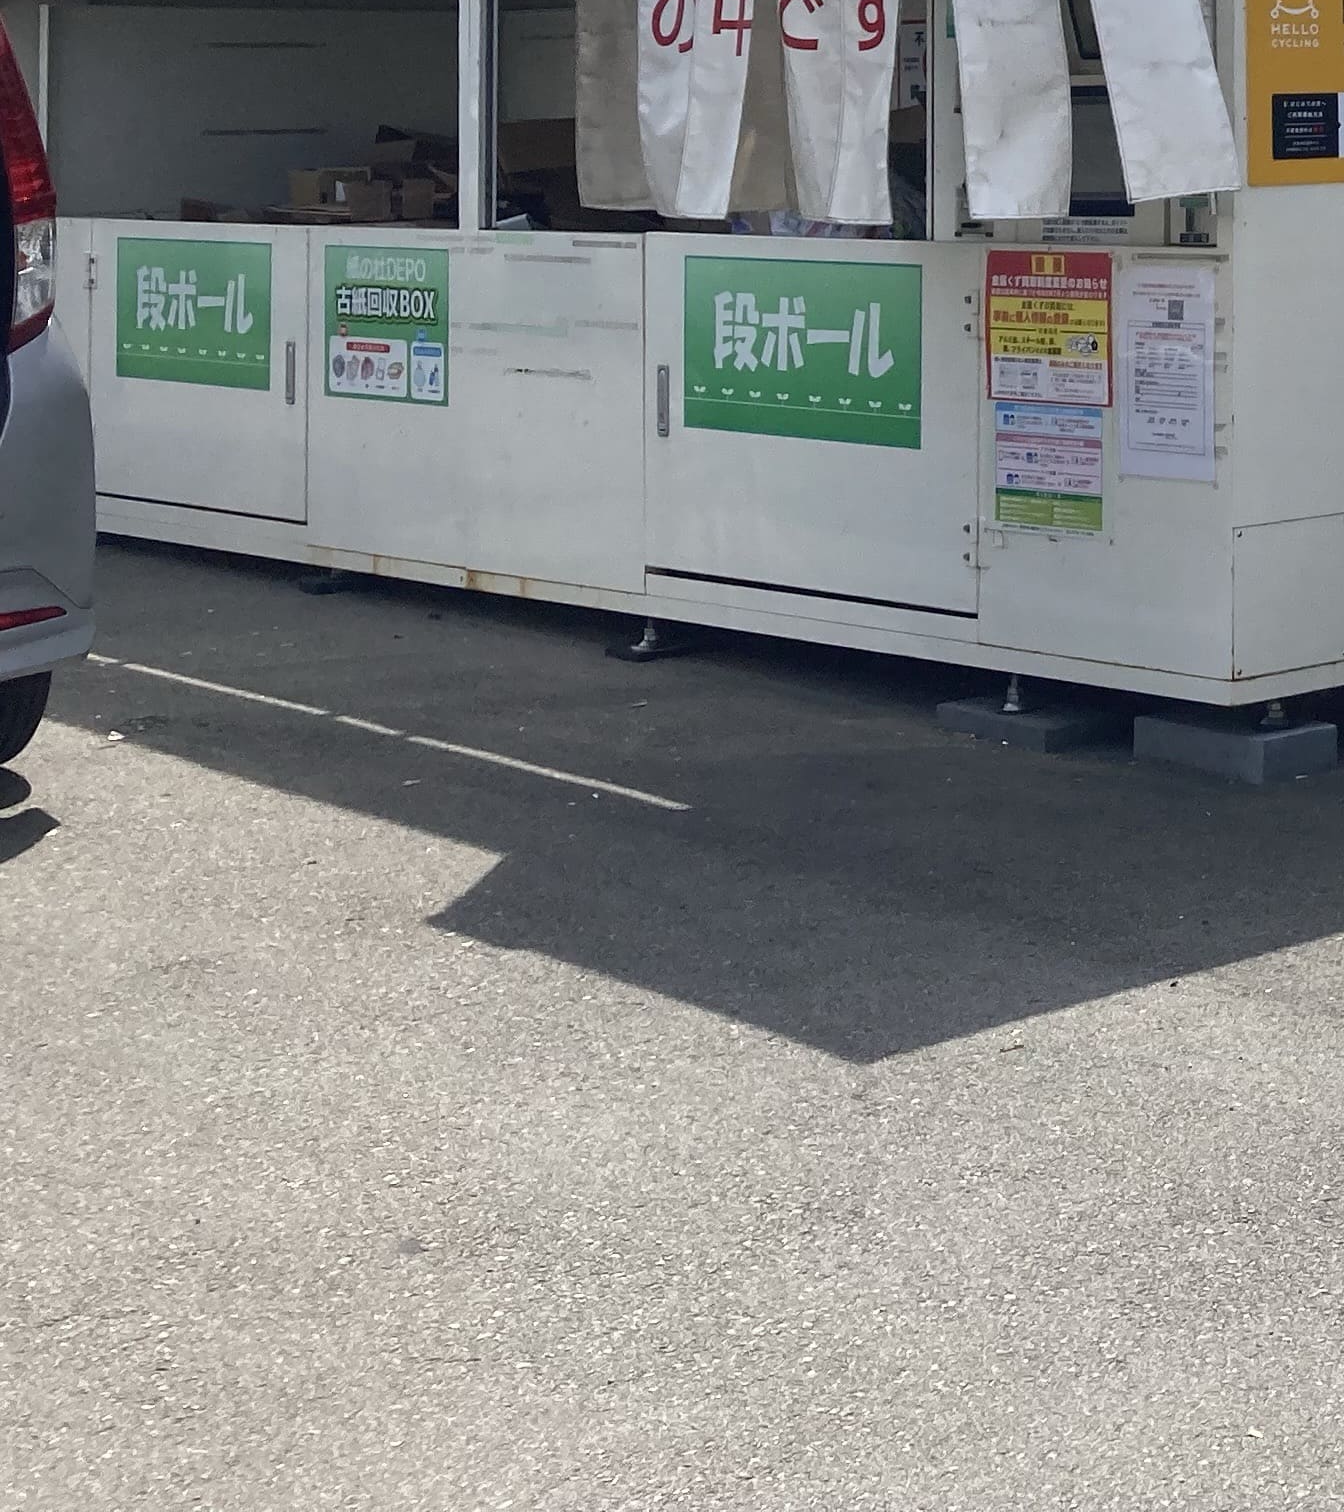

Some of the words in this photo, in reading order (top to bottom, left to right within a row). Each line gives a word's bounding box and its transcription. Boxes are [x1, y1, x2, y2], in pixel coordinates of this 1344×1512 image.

[1271, 23, 1320, 35] HELLO
[1271, 38, 1320, 48] CYCLING
[135, 264, 255, 335] 段ボール
[335, 285, 435, 320] 古紙回収BOX
[713, 290, 896, 378] 段ボール
